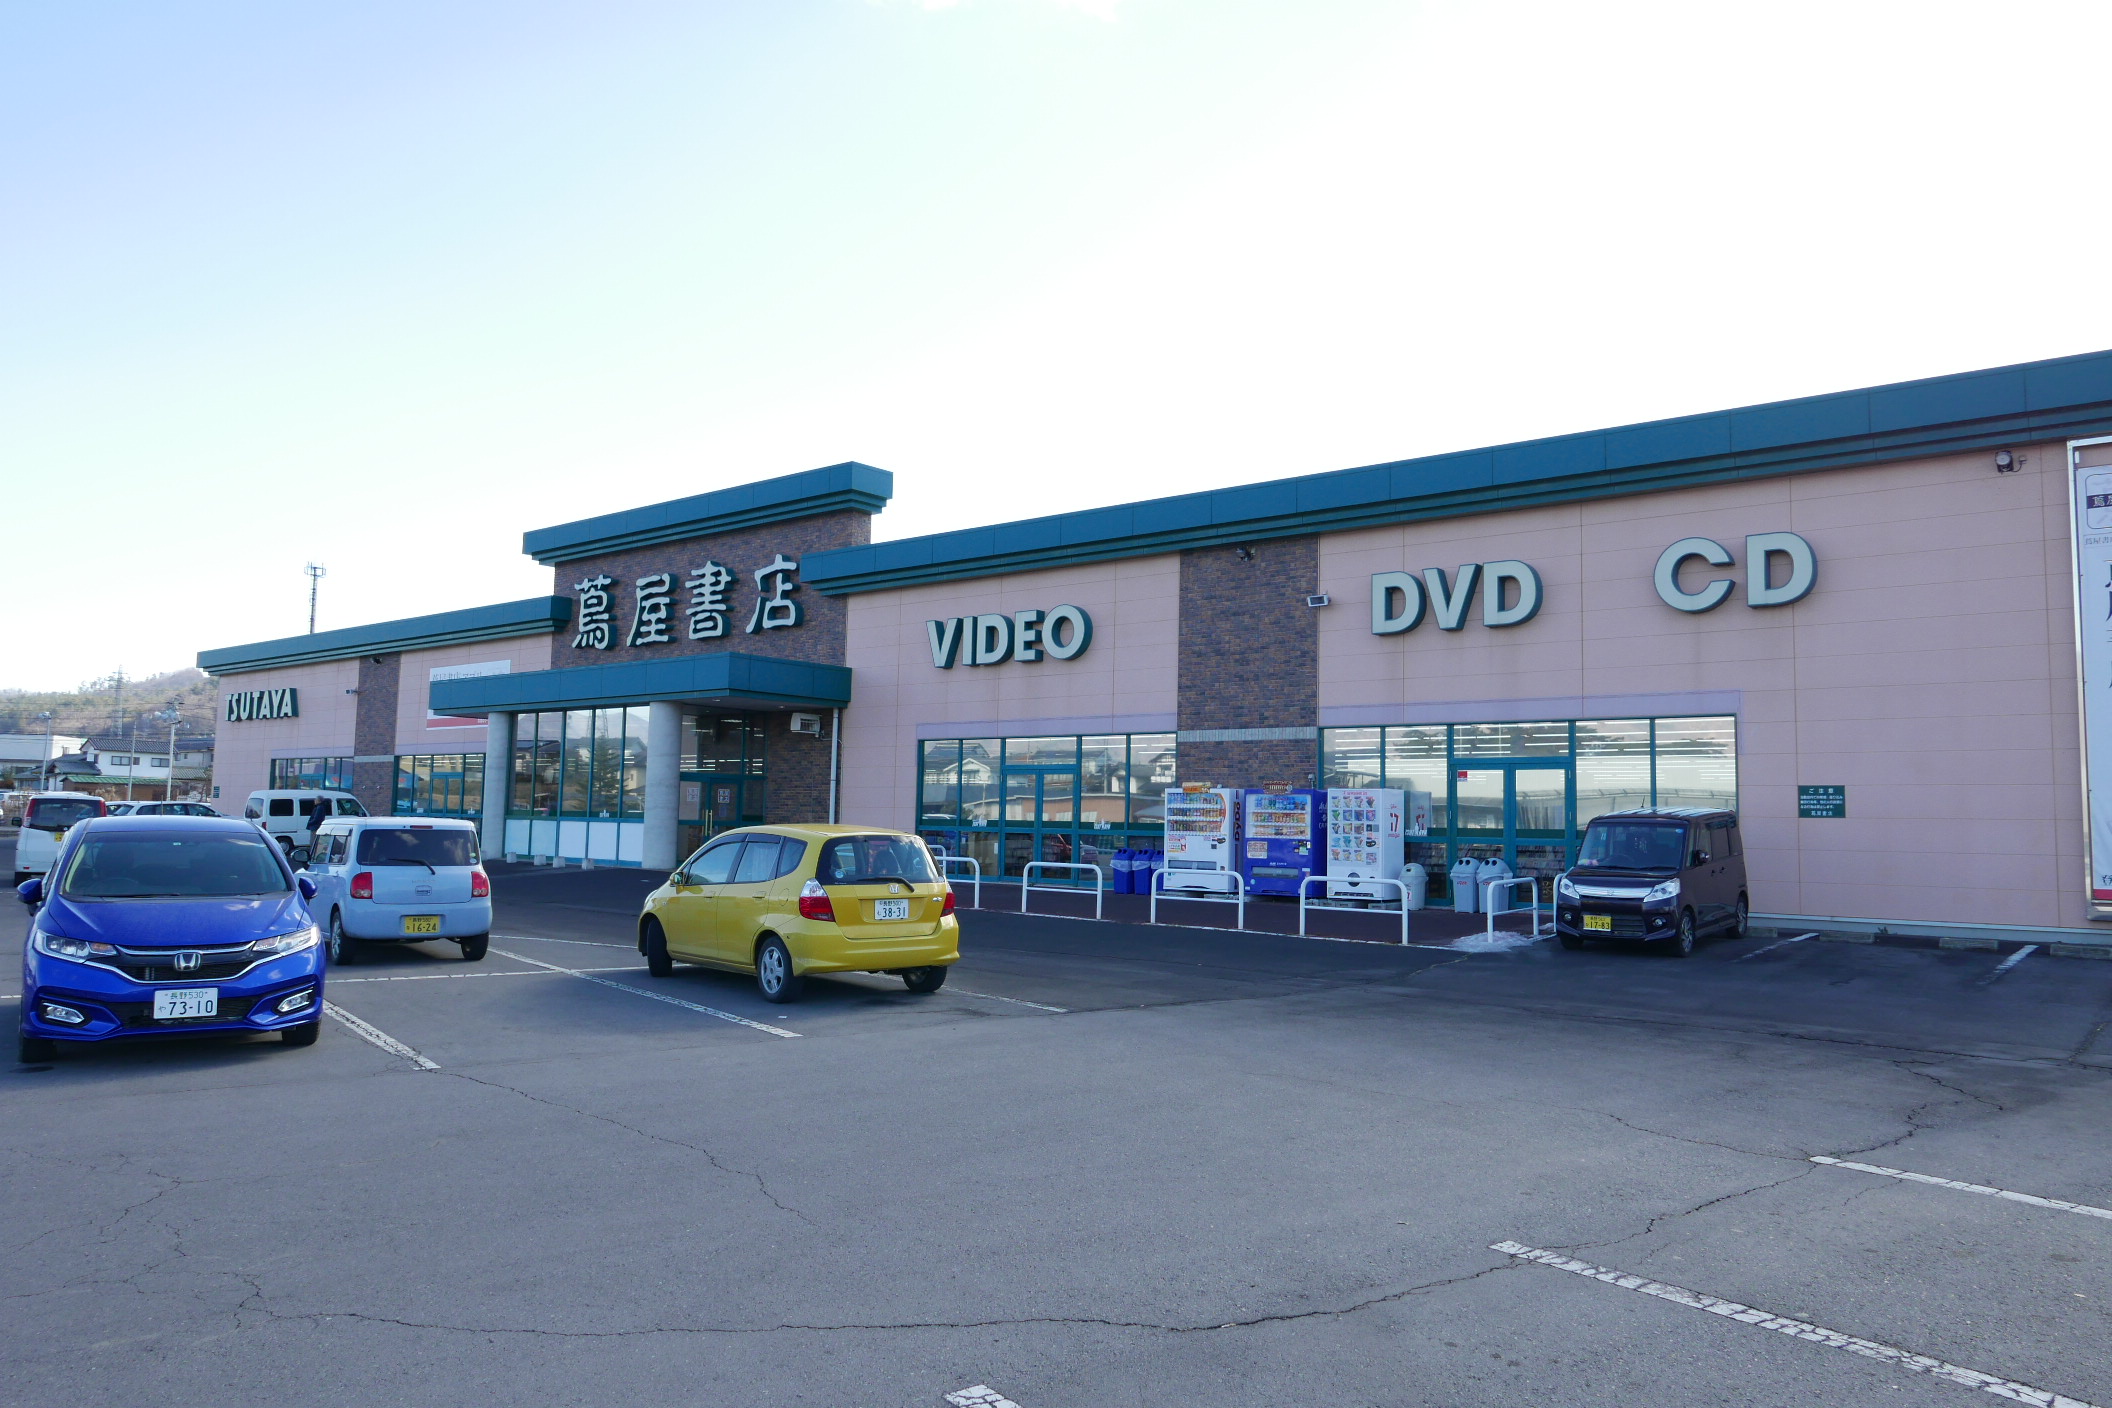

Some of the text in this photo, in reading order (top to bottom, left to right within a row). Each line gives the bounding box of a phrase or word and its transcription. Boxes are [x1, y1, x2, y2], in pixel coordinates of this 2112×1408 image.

[1371, 559, 1544, 636] DVD
[1654, 531, 1818, 614] CD
[572, 553, 803, 650] 蔦屋書店
[925, 603, 1094, 668] VIDEO
[225, 687, 299, 722] TSUTAYA
[412, 922, 437, 932] 16-24
[882, 906, 906, 918] 38-31
[168, 999, 213, 1016] 73-10
